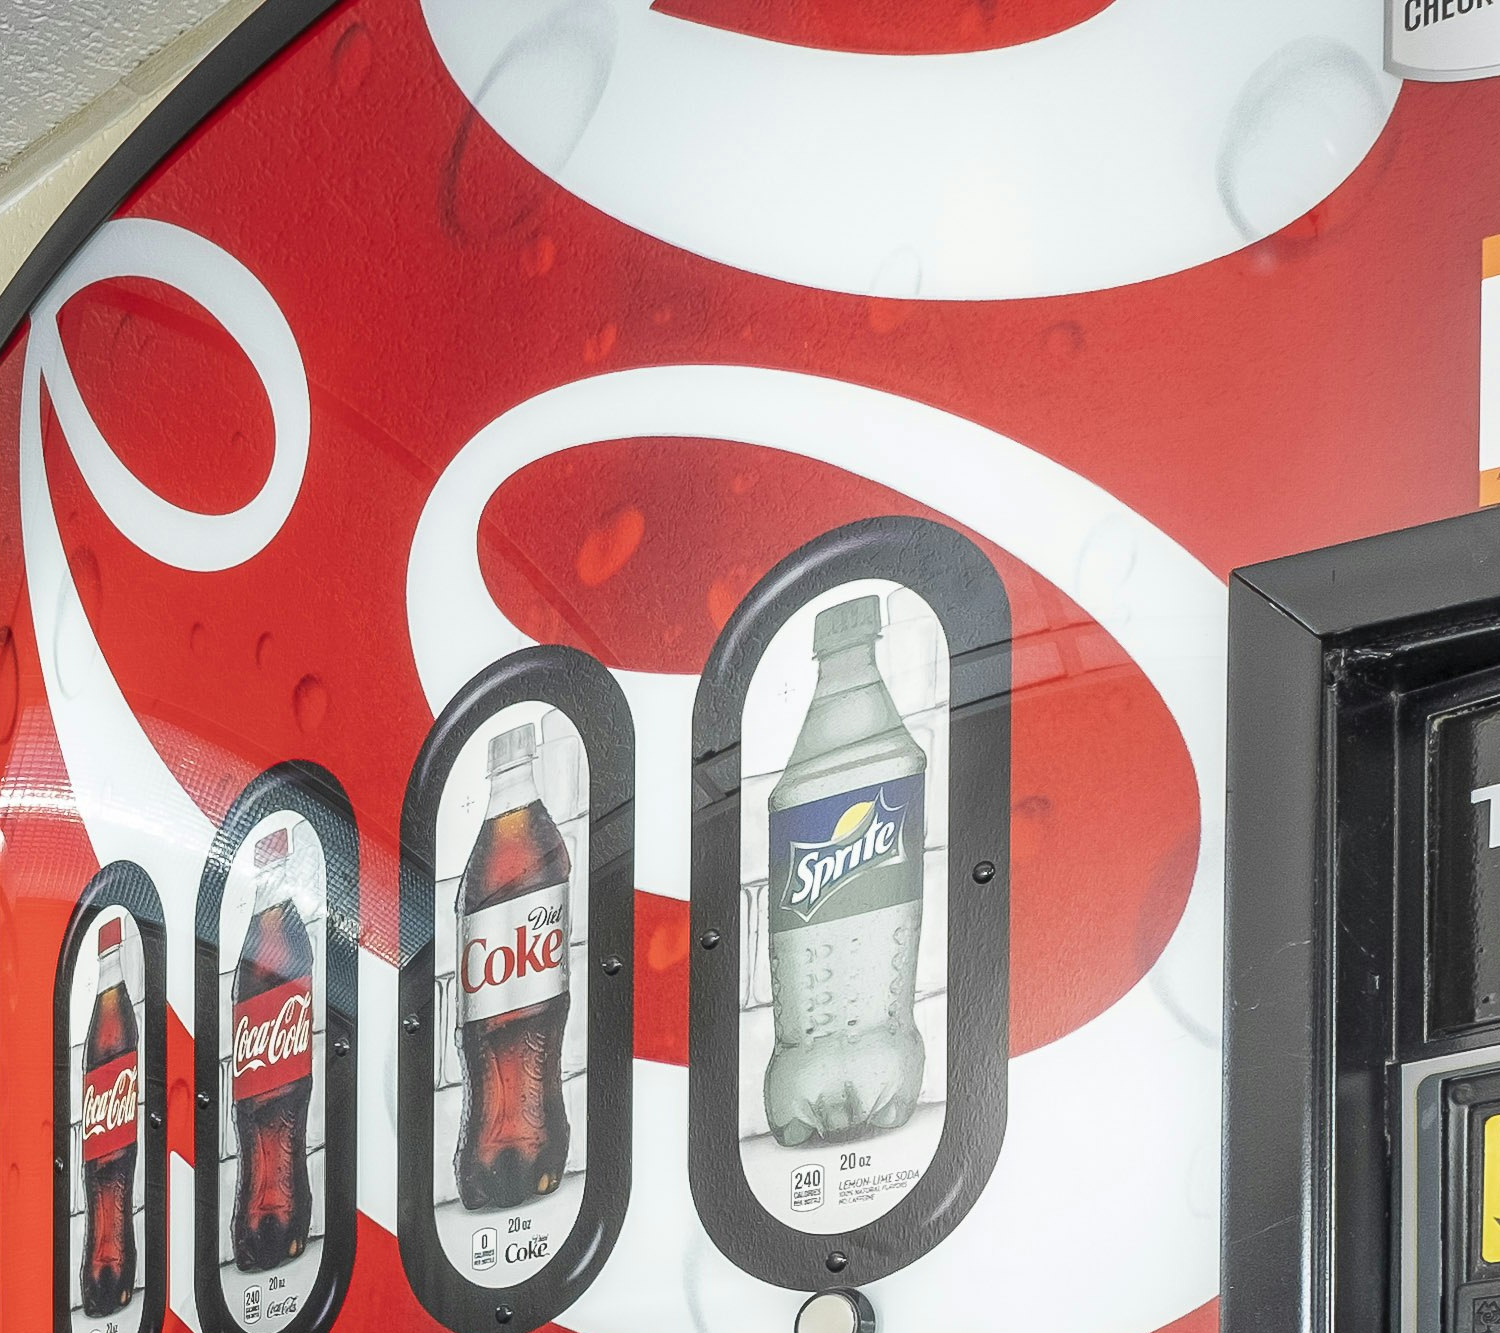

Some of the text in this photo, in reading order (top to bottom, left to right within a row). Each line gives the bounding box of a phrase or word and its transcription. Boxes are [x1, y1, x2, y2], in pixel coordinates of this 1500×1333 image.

[1404, 0, 1493, 31] CHE
[791, 812, 896, 905] Sprite
[527, 904, 563, 931] Diet
[461, 925, 564, 994] Coke
[233, 991, 312, 1078] Coca-Cola
[82, 1065, 138, 1141] Coca-Cola
[839, 1152, 872, 1171] 20 oz
[794, 1169, 821, 1190] 240
[894, 1169, 920, 1182] SODA
[507, 1216, 532, 1233] 20 oz
[481, 1234, 488, 1250] 0
[505, 1240, 551, 1264] Coke
[269, 1276, 278, 1291] 20
[246, 1290, 260, 1306] 240
